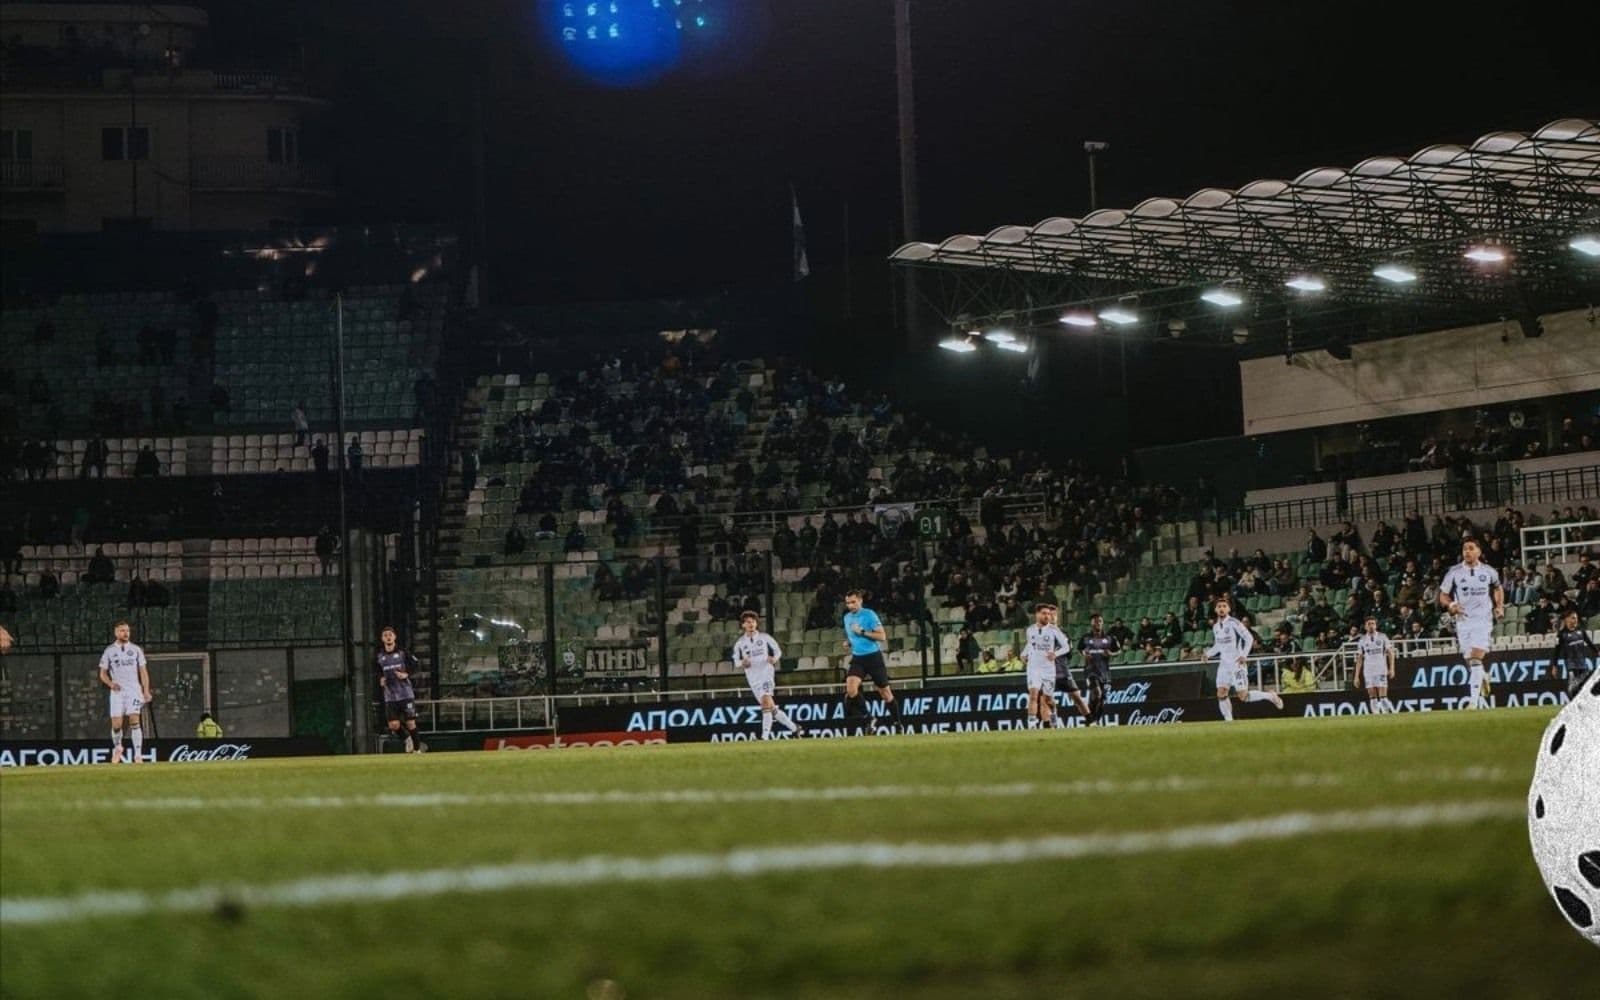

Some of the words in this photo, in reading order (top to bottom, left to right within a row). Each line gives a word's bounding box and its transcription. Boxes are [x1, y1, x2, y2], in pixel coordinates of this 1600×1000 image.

[586, 649, 646, 670] ATHENS
[1412, 659, 1550, 688] ΑΠΟΑΥΣΕ
[1104, 682, 1152, 704] oca-Cola
[626, 703, 778, 732] ΑΠΟΛΑΥΣ
[783, 702, 828, 721] ΤΟΝ
[937, 695, 972, 714] ΜΙΑ
[1303, 698, 1435, 718] ΑΠΟΛΥΣΕ
